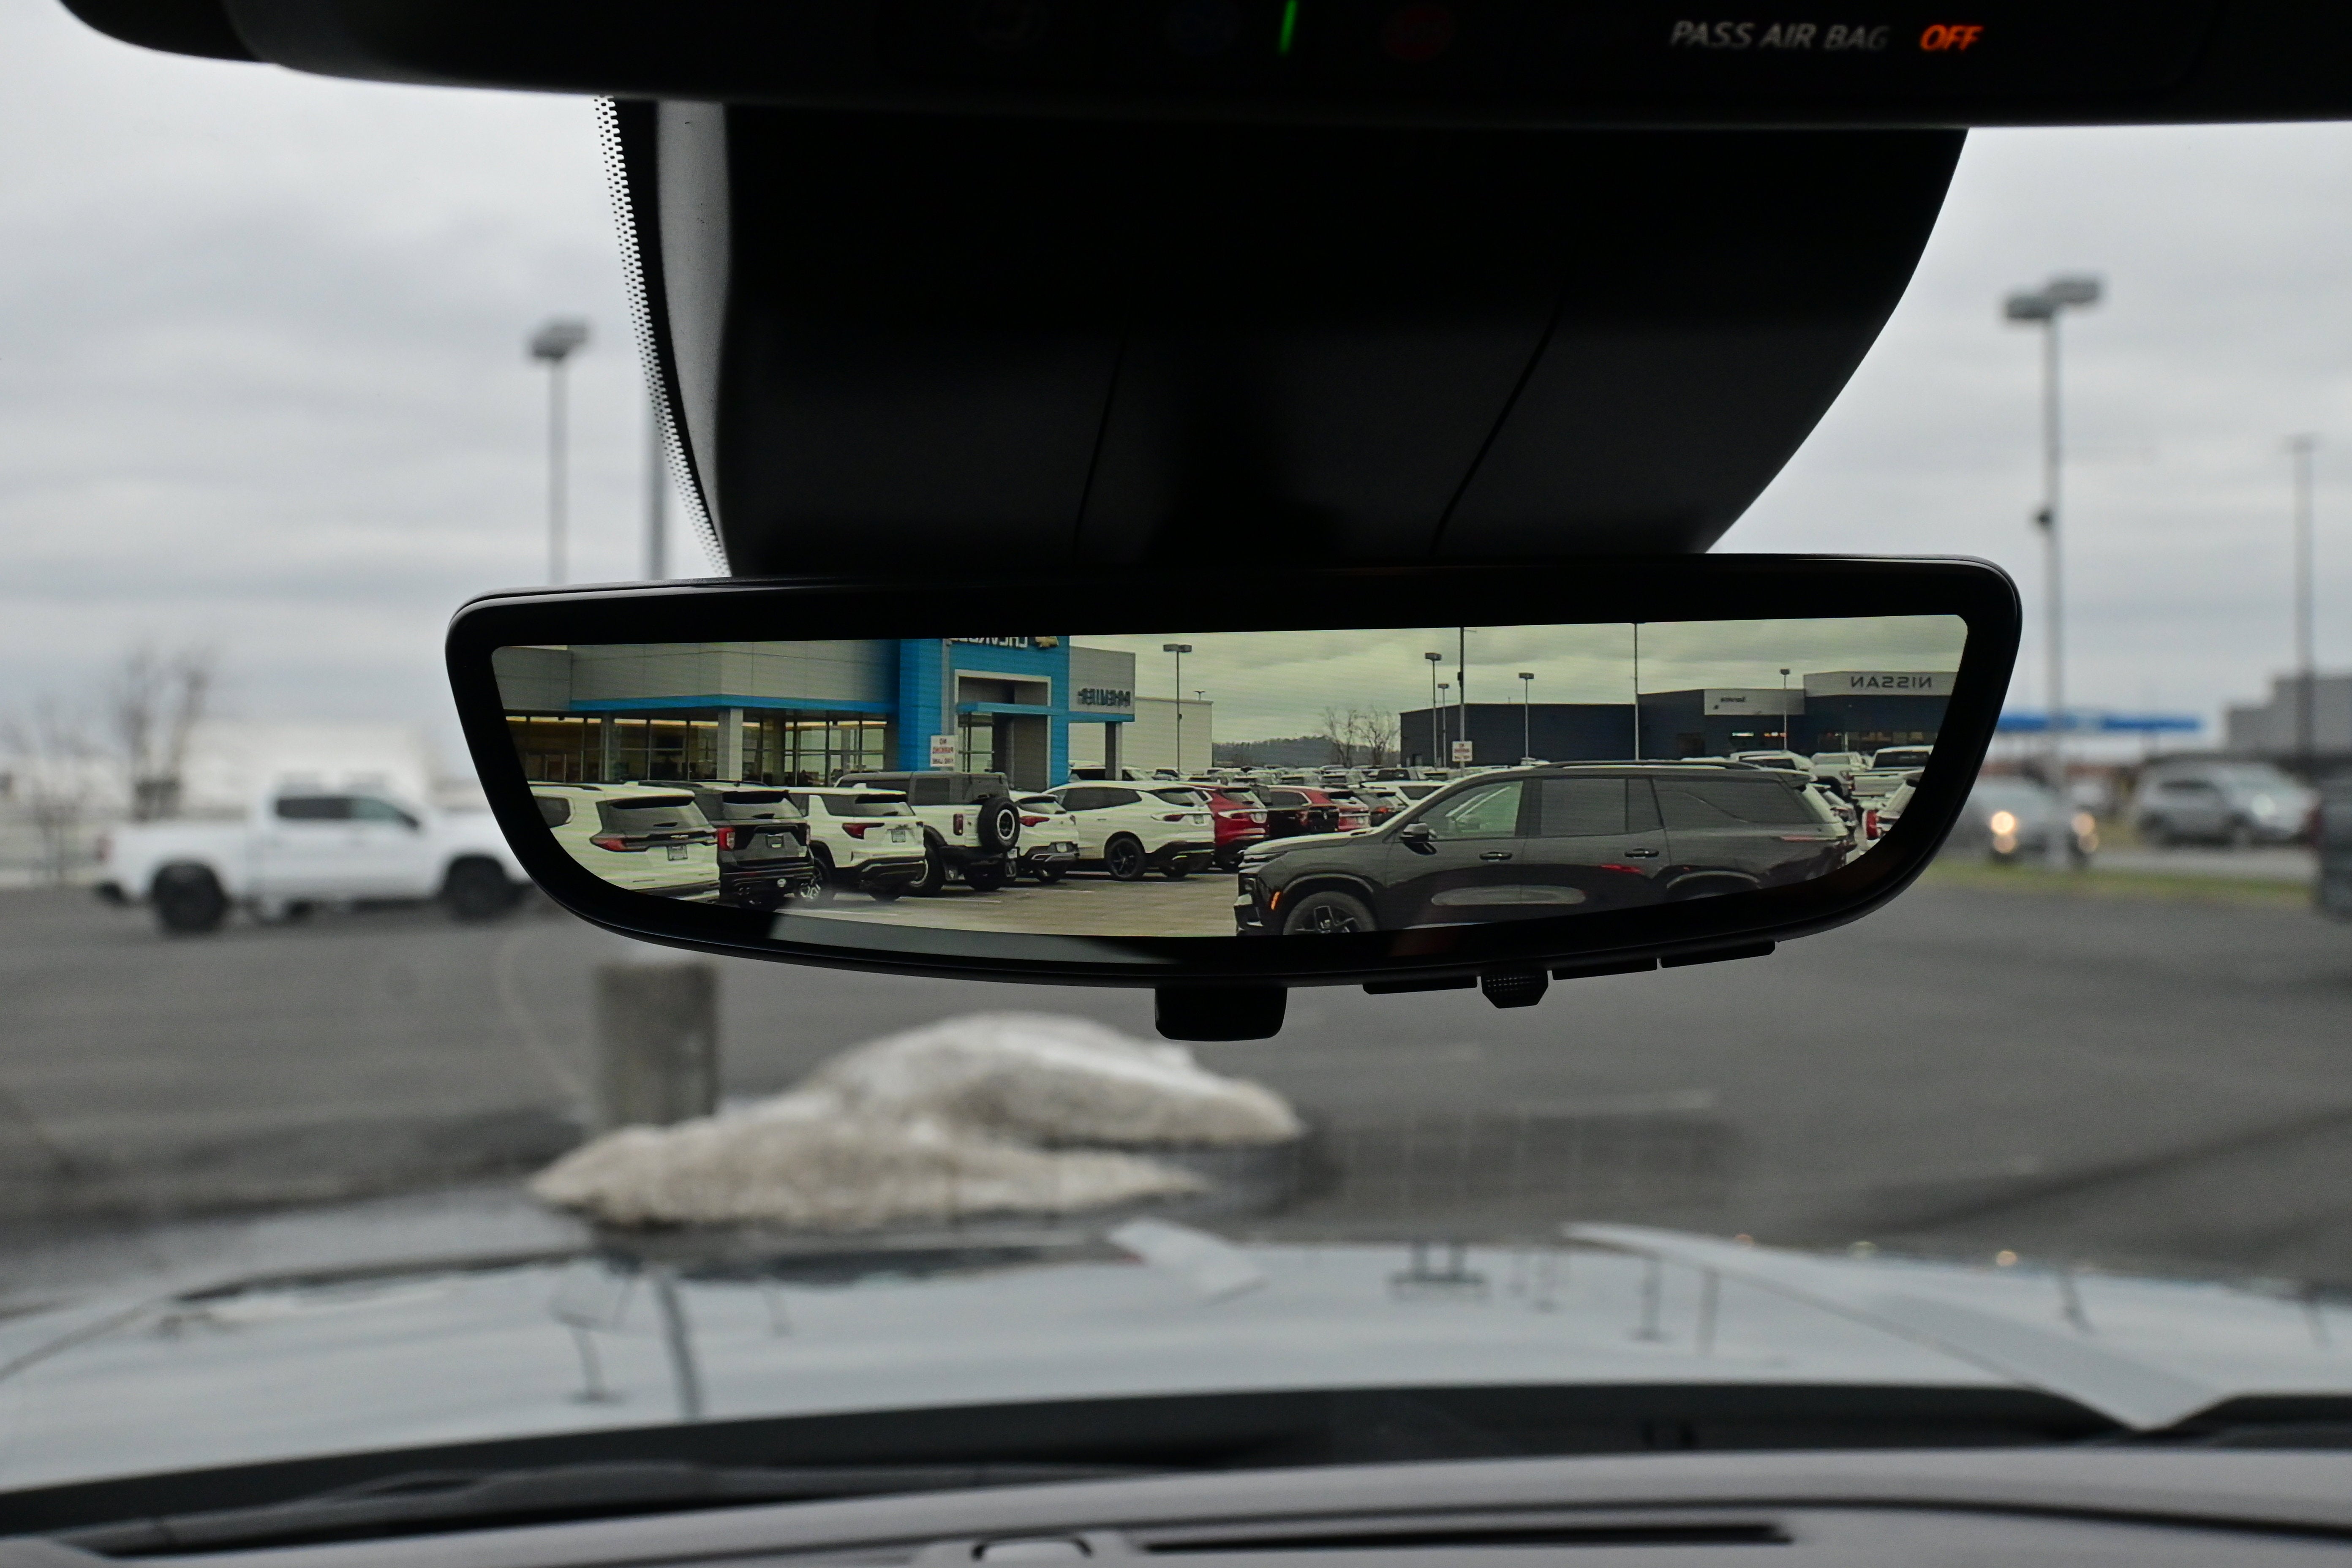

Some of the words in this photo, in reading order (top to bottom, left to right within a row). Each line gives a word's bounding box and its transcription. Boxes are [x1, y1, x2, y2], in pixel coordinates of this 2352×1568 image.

[1669, 19, 1756, 49] PASS
[1757, 22, 1816, 49] AIR
[1823, 24, 1891, 51] BAG
[1919, 24, 1984, 51] OFF
